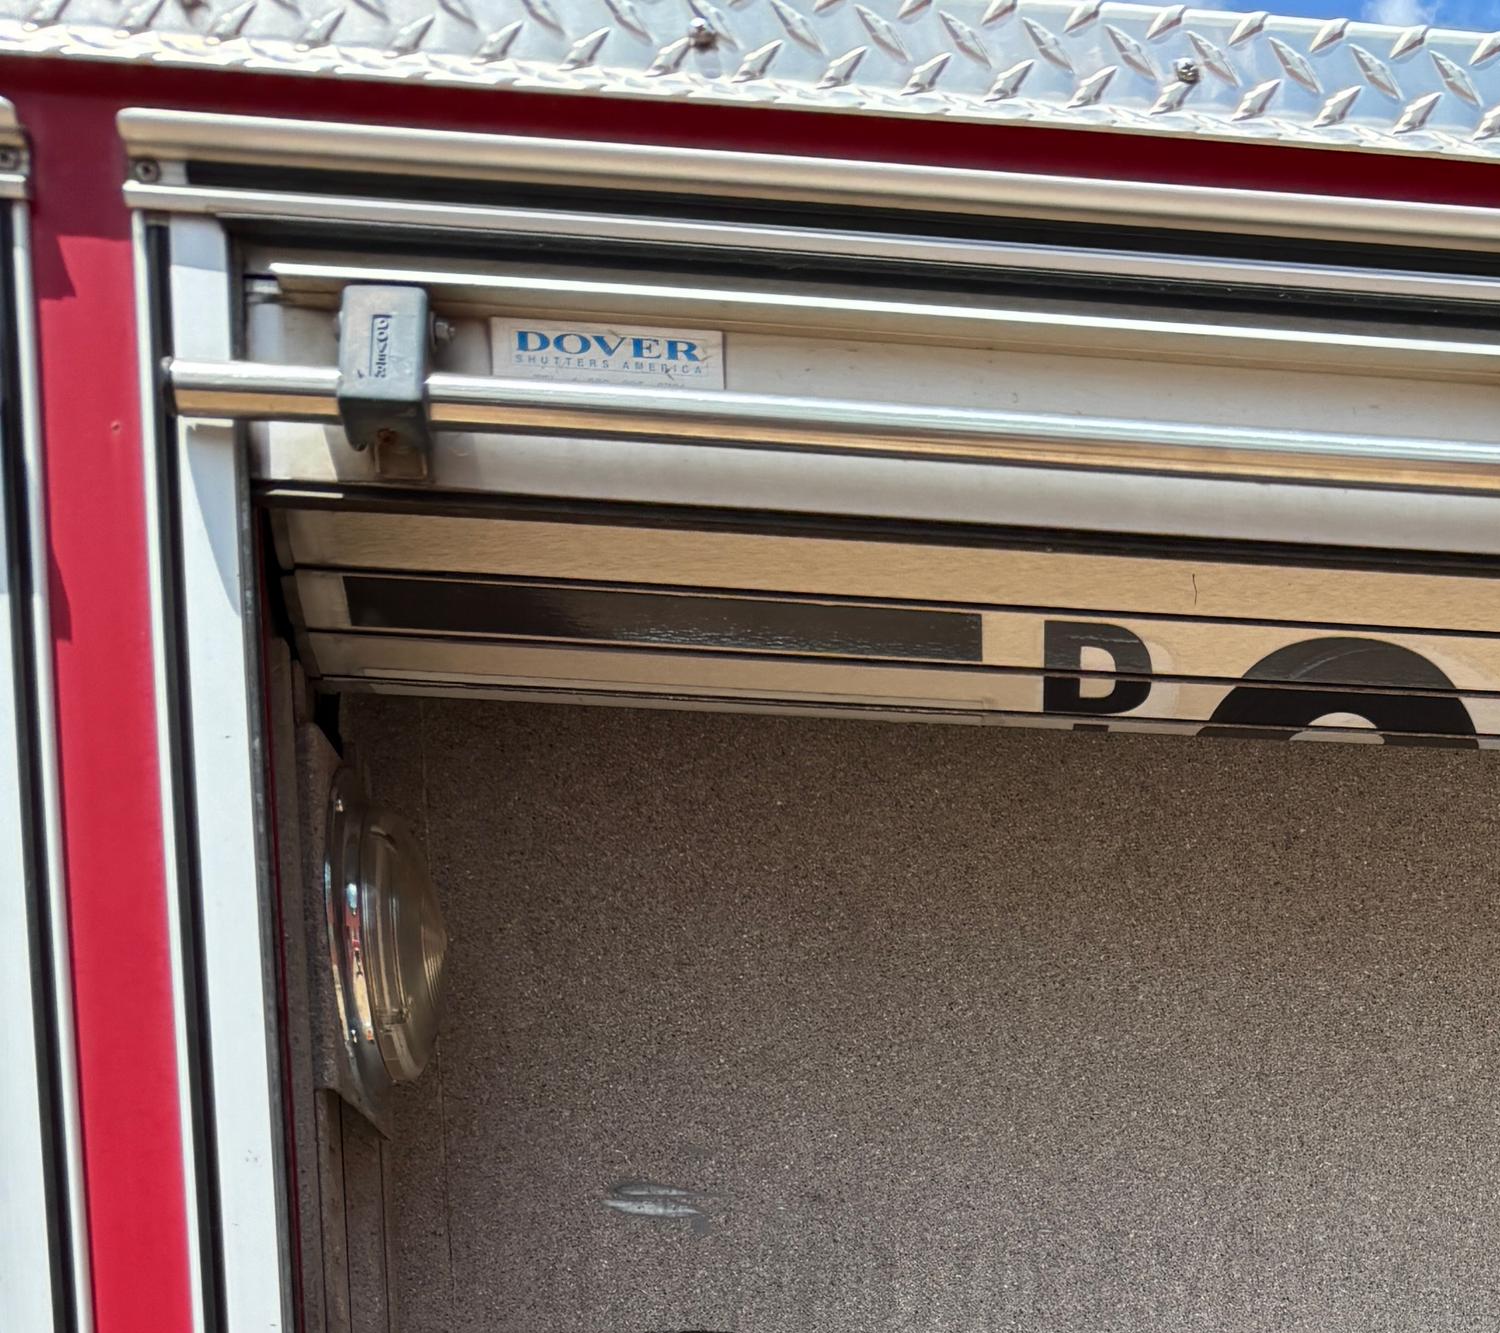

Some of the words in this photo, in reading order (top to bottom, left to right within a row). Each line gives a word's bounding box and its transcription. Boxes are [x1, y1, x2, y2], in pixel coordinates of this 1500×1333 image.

[516, 330, 702, 362] DOVER
[515, 354, 610, 369] SHUTTERS
[622, 361, 703, 374] AMERICA
